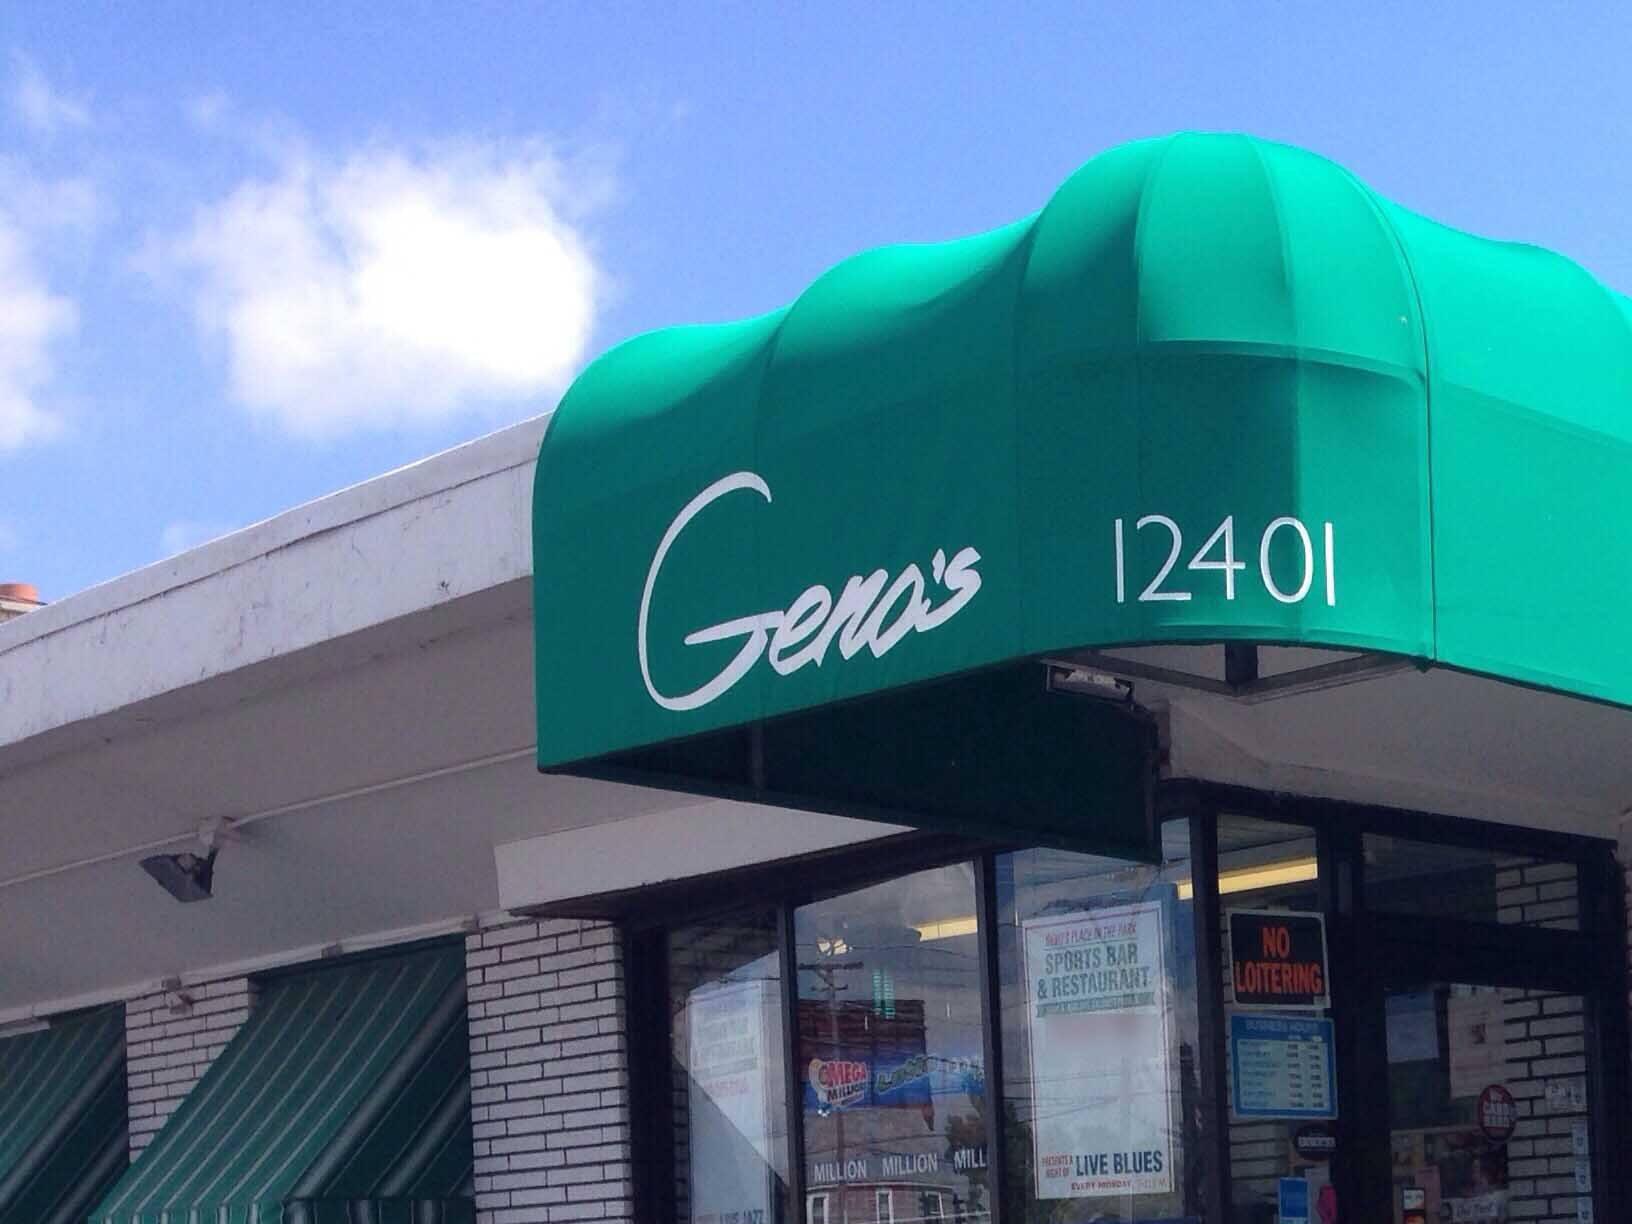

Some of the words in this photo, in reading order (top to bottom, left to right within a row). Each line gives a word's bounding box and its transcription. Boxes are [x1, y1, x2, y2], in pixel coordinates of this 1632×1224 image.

[1114, 514, 1336, 606] 12401
[637, 471, 982, 710] Geno's
[1262, 926, 1290, 957] NO
[1045, 947, 1101, 976] SPORTS
[1106, 942, 1139, 968] BAR
[1037, 978, 1048, 999] &
[1052, 966, 1151, 998] RESTAURANT
[1235, 961, 1322, 994] LOITERING
[819, 1061, 867, 1088] MEGA
[814, 1159, 867, 1182] MILLION
[882, 1153, 938, 1177] MILLION
[954, 1146, 986, 1169] MILL
[1076, 1153, 1109, 1177] LIVE
[1113, 1150, 1163, 1175] BLUES
[1071, 1181, 1096, 1191] EVERY
